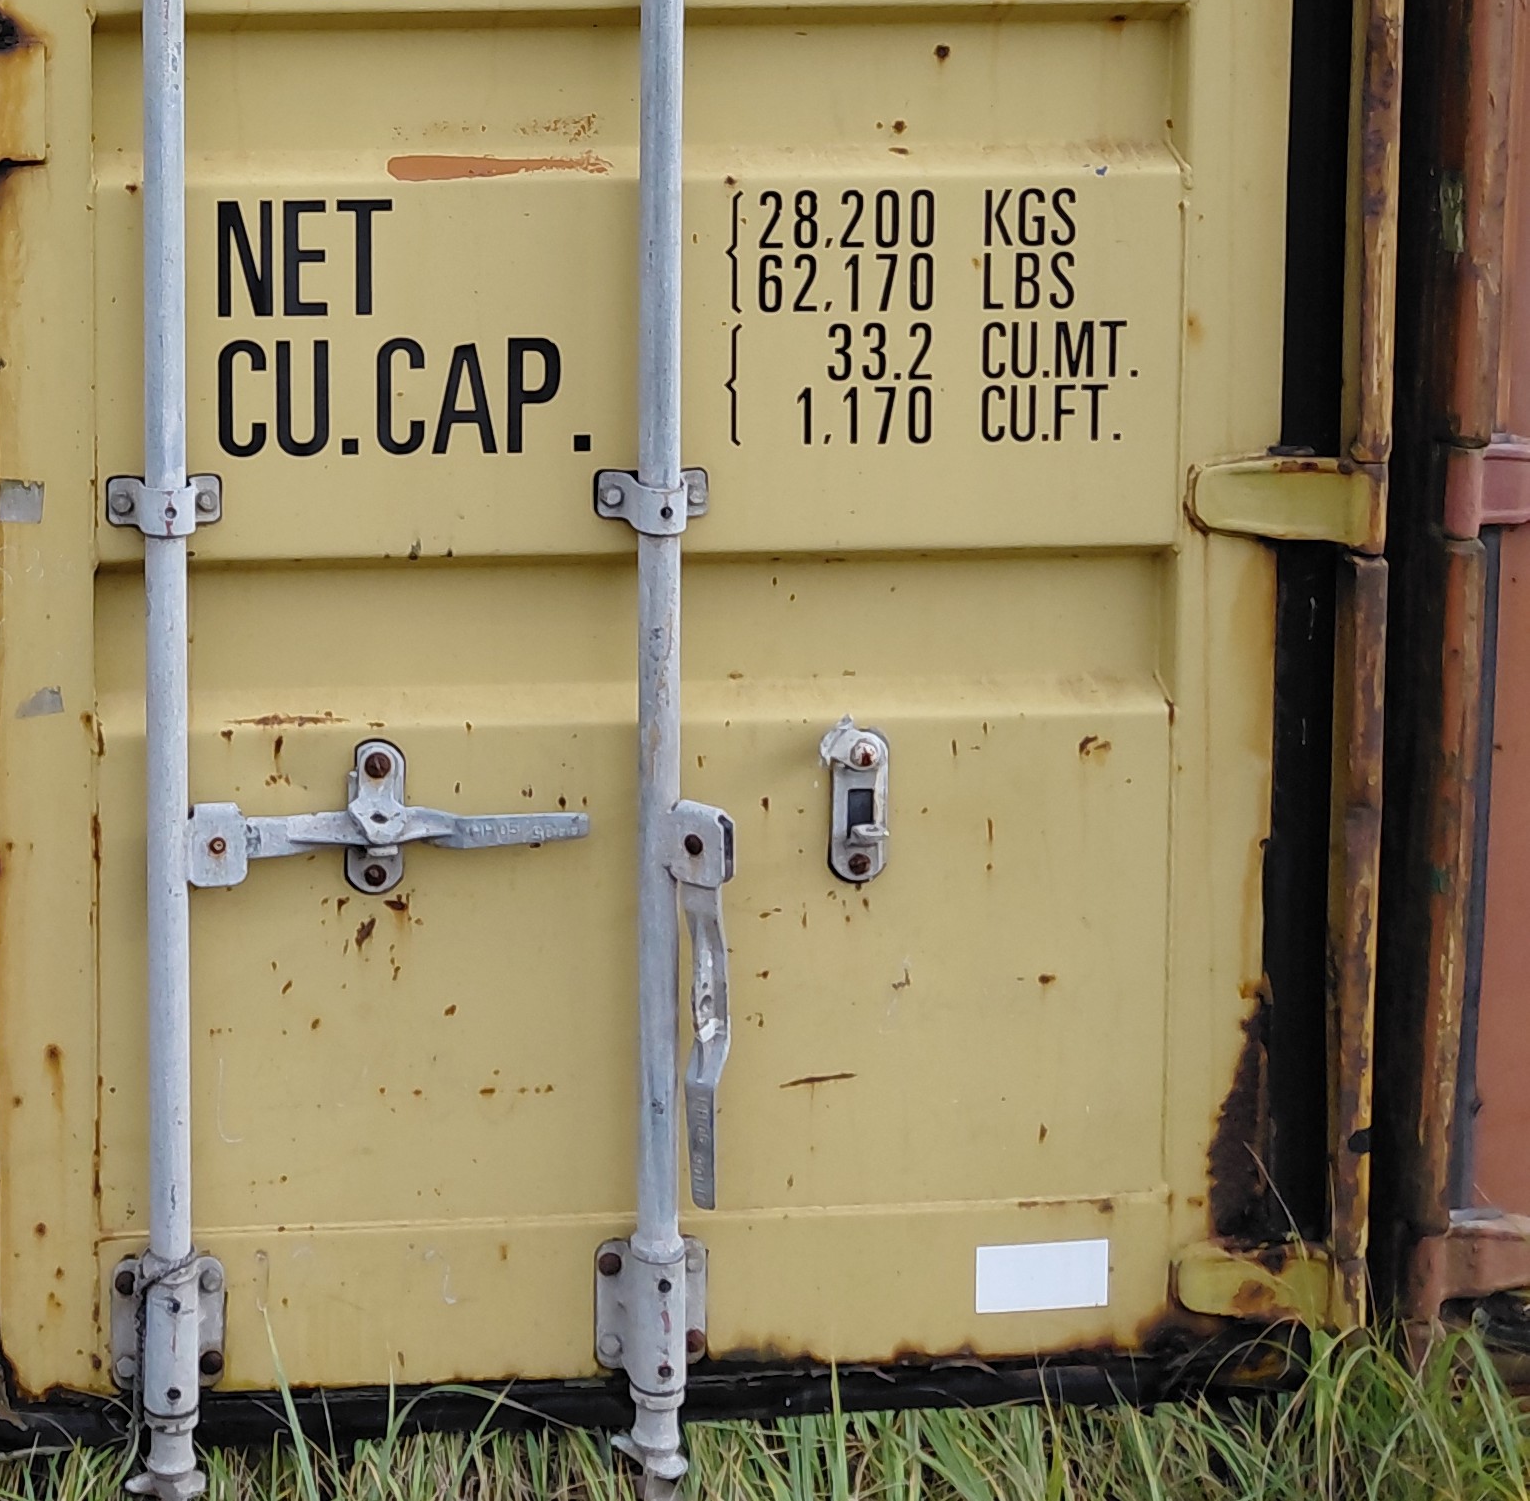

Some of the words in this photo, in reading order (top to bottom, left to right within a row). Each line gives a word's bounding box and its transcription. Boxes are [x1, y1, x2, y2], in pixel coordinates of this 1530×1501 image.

[758, 188, 935, 250] 28,200
[983, 187, 1077, 248] KGS
[216, 197, 393, 318] NET
[757, 252, 934, 313] 62,170
[982, 251, 1076, 310] LBS
[826, 321, 933, 381] 33.2
[981, 319, 1140, 379] CU.MT.
[796, 385, 933, 445] 1,170
[980, 383, 1123, 442] CU.FT.
